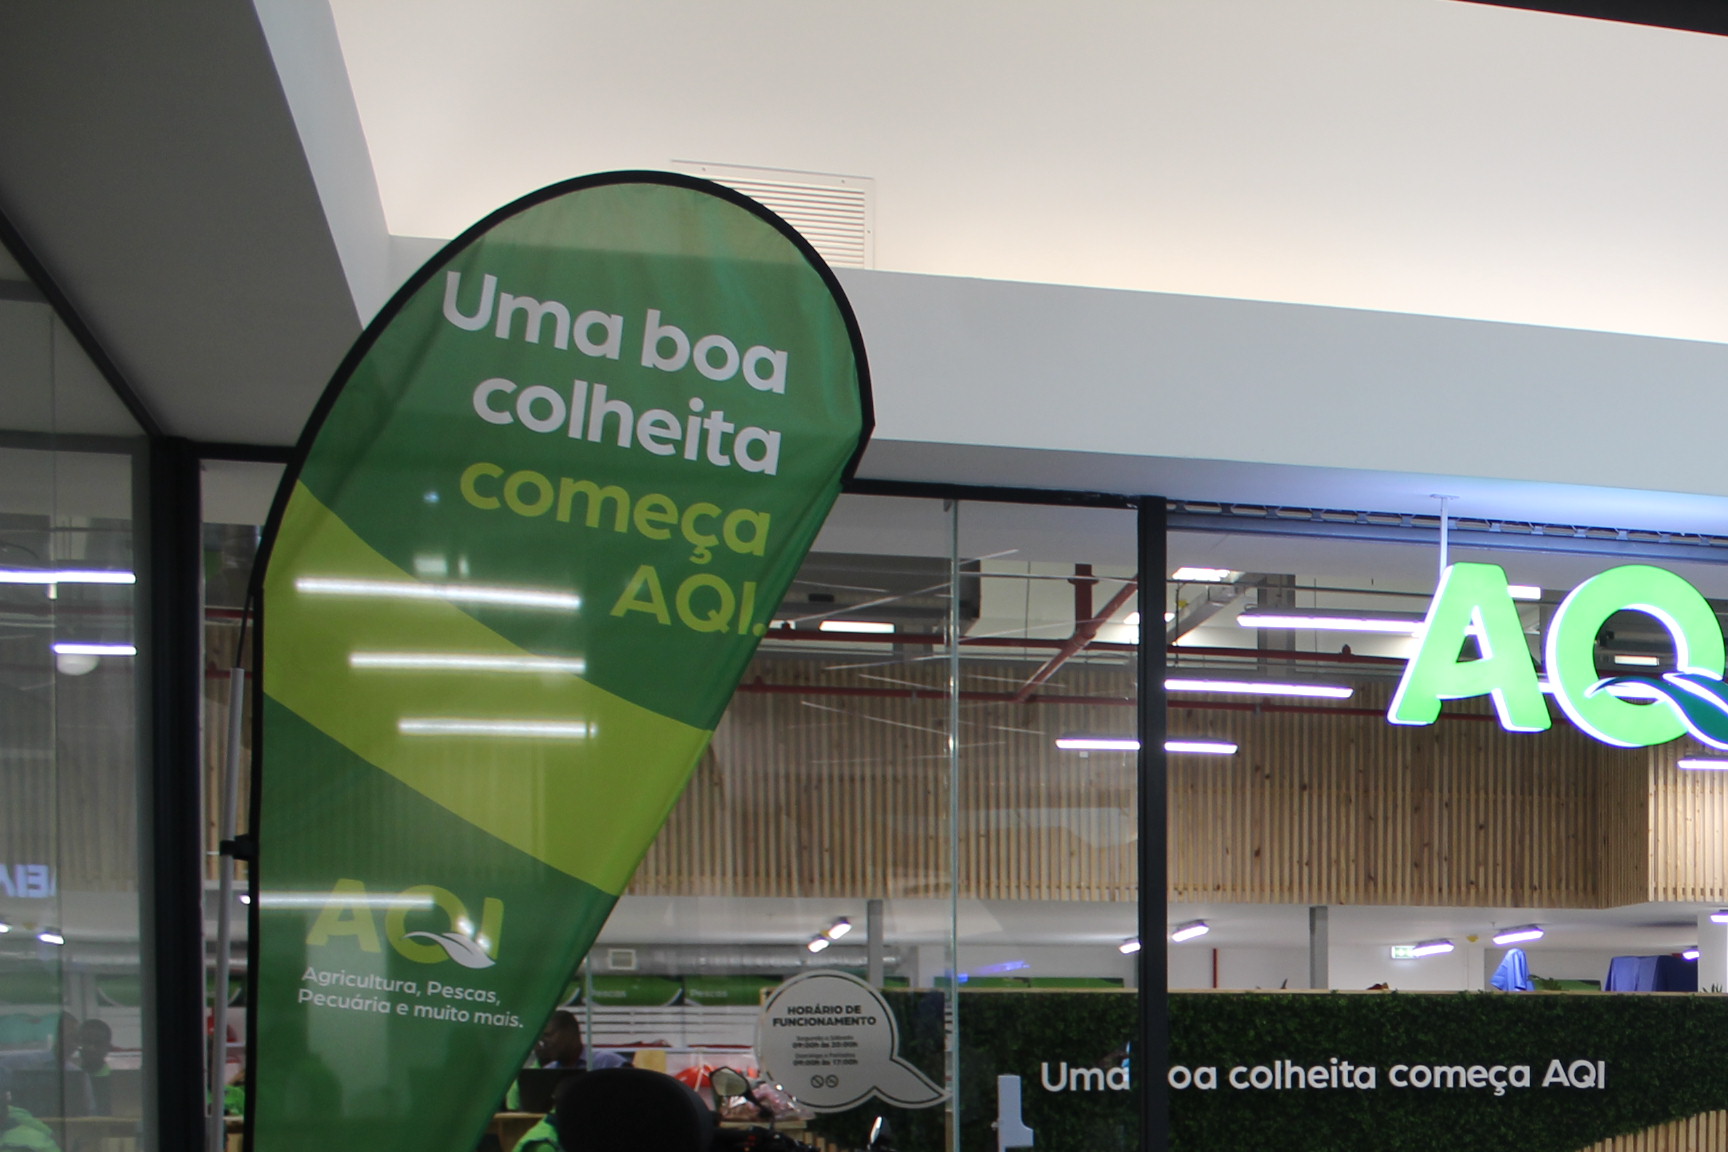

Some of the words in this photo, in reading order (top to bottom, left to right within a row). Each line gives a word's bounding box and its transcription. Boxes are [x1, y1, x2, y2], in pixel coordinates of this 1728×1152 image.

[442, 271, 624, 360] Uma
[641, 309, 788, 394] boa
[472, 377, 781, 475] colheita
[460, 462, 771, 563] começa
[305, 878, 504, 968] AQI
[302, 967, 421, 997] Agricultura,
[427, 981, 501, 1006] Pescas,
[298, 988, 391, 1014] Pecuária
[396, 1003, 409, 1015] e
[414, 1005, 469, 1022] muito
[474, 1011, 524, 1028] mais.
[773, 1016, 876, 1027] FUNCIONAMENTO
[787, 1004, 843, 1015] HORÁRIO
[845, 1005, 861, 1014] DE
[1041, 1062, 1130, 1091] Uma
[1168, 1065, 1217, 1090] oa
[1229, 1057, 1376, 1090] colheita
[1389, 1064, 1530, 1096] começa
[1542, 1059, 1605, 1089] AQI
